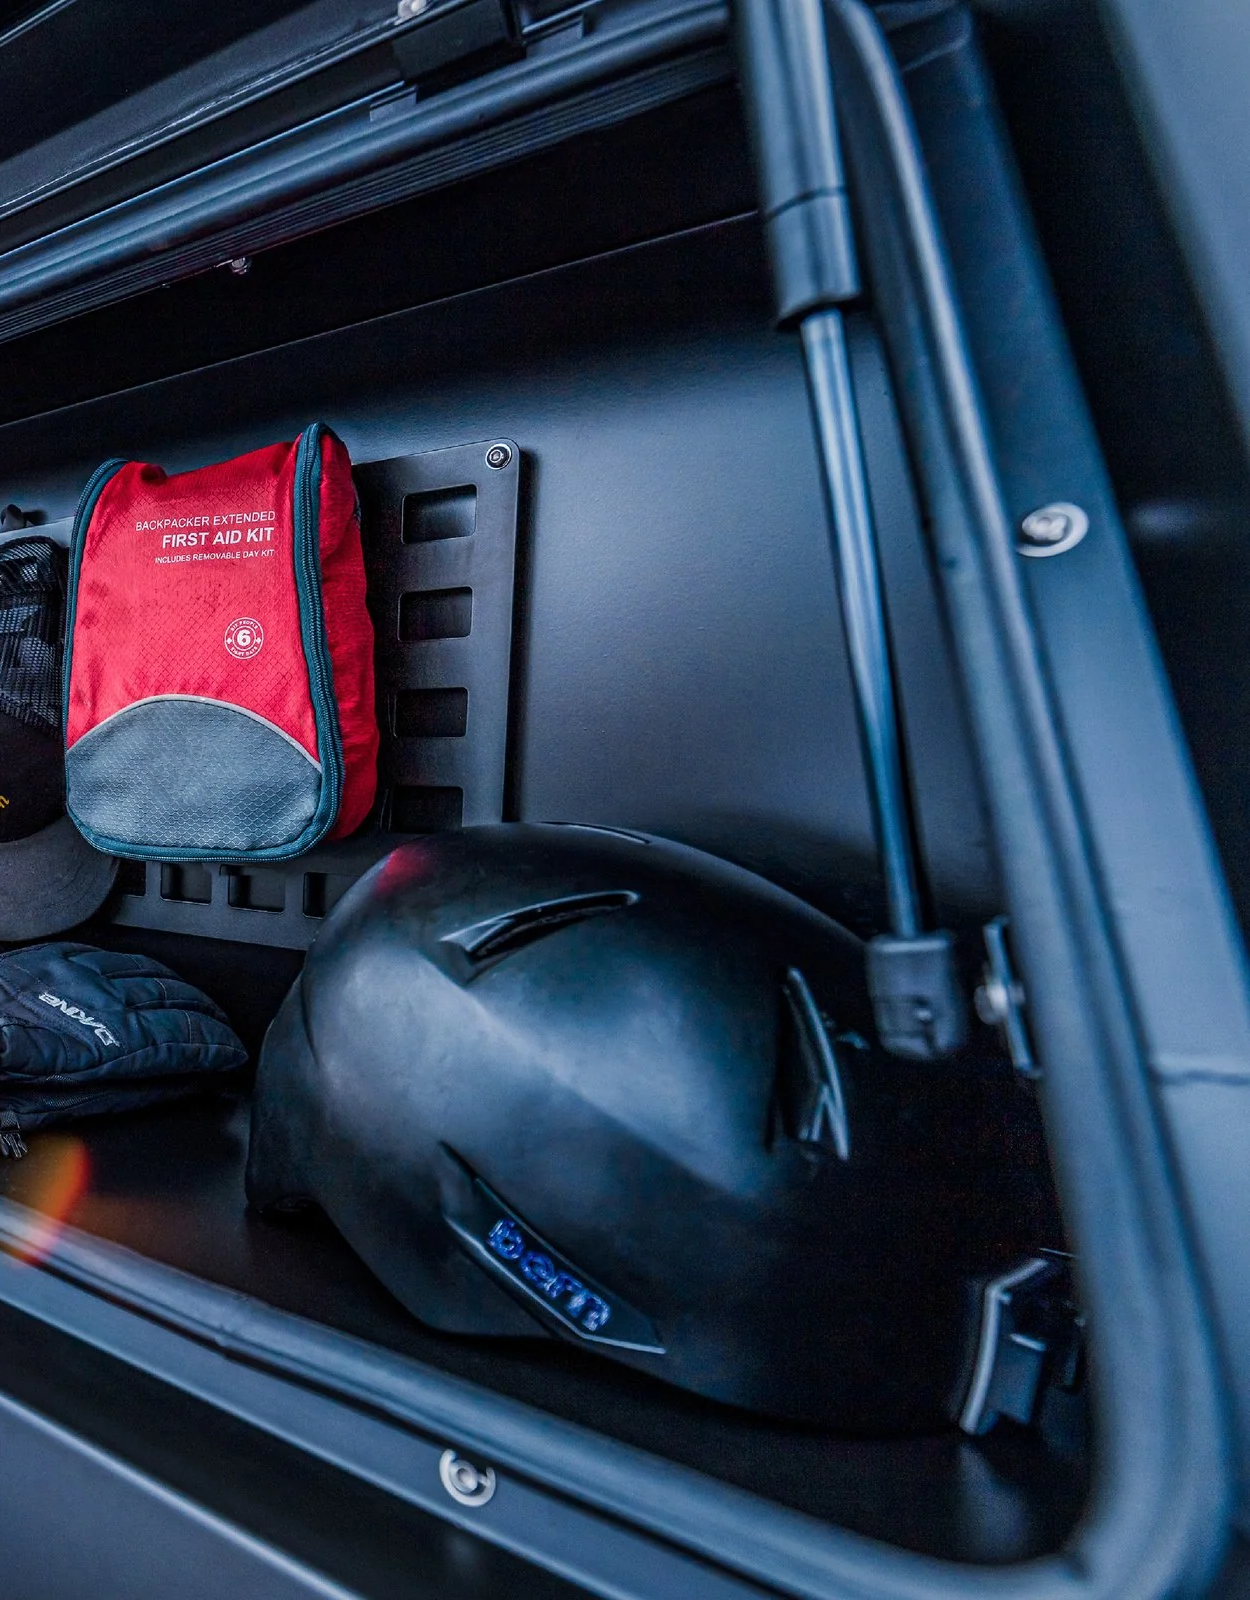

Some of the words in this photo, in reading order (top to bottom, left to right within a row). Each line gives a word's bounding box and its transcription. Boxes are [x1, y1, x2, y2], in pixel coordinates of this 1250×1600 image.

[135, 516, 210, 531] BACKPACKER
[213, 510, 276, 526] EXTENDED
[162, 532, 209, 548] FIRST
[212, 529, 242, 545] AID
[246, 527, 275, 543] KIT
[154, 554, 191, 565] INCLUDES
[192, 550, 241, 561] REMOVABLE
[243, 549, 259, 559] DAY
[261, 549, 275, 557] KIT
[236, 628, 251, 647] 6
[38, 992, 120, 1047] DAKINE
[486, 1218, 611, 1332] bern
